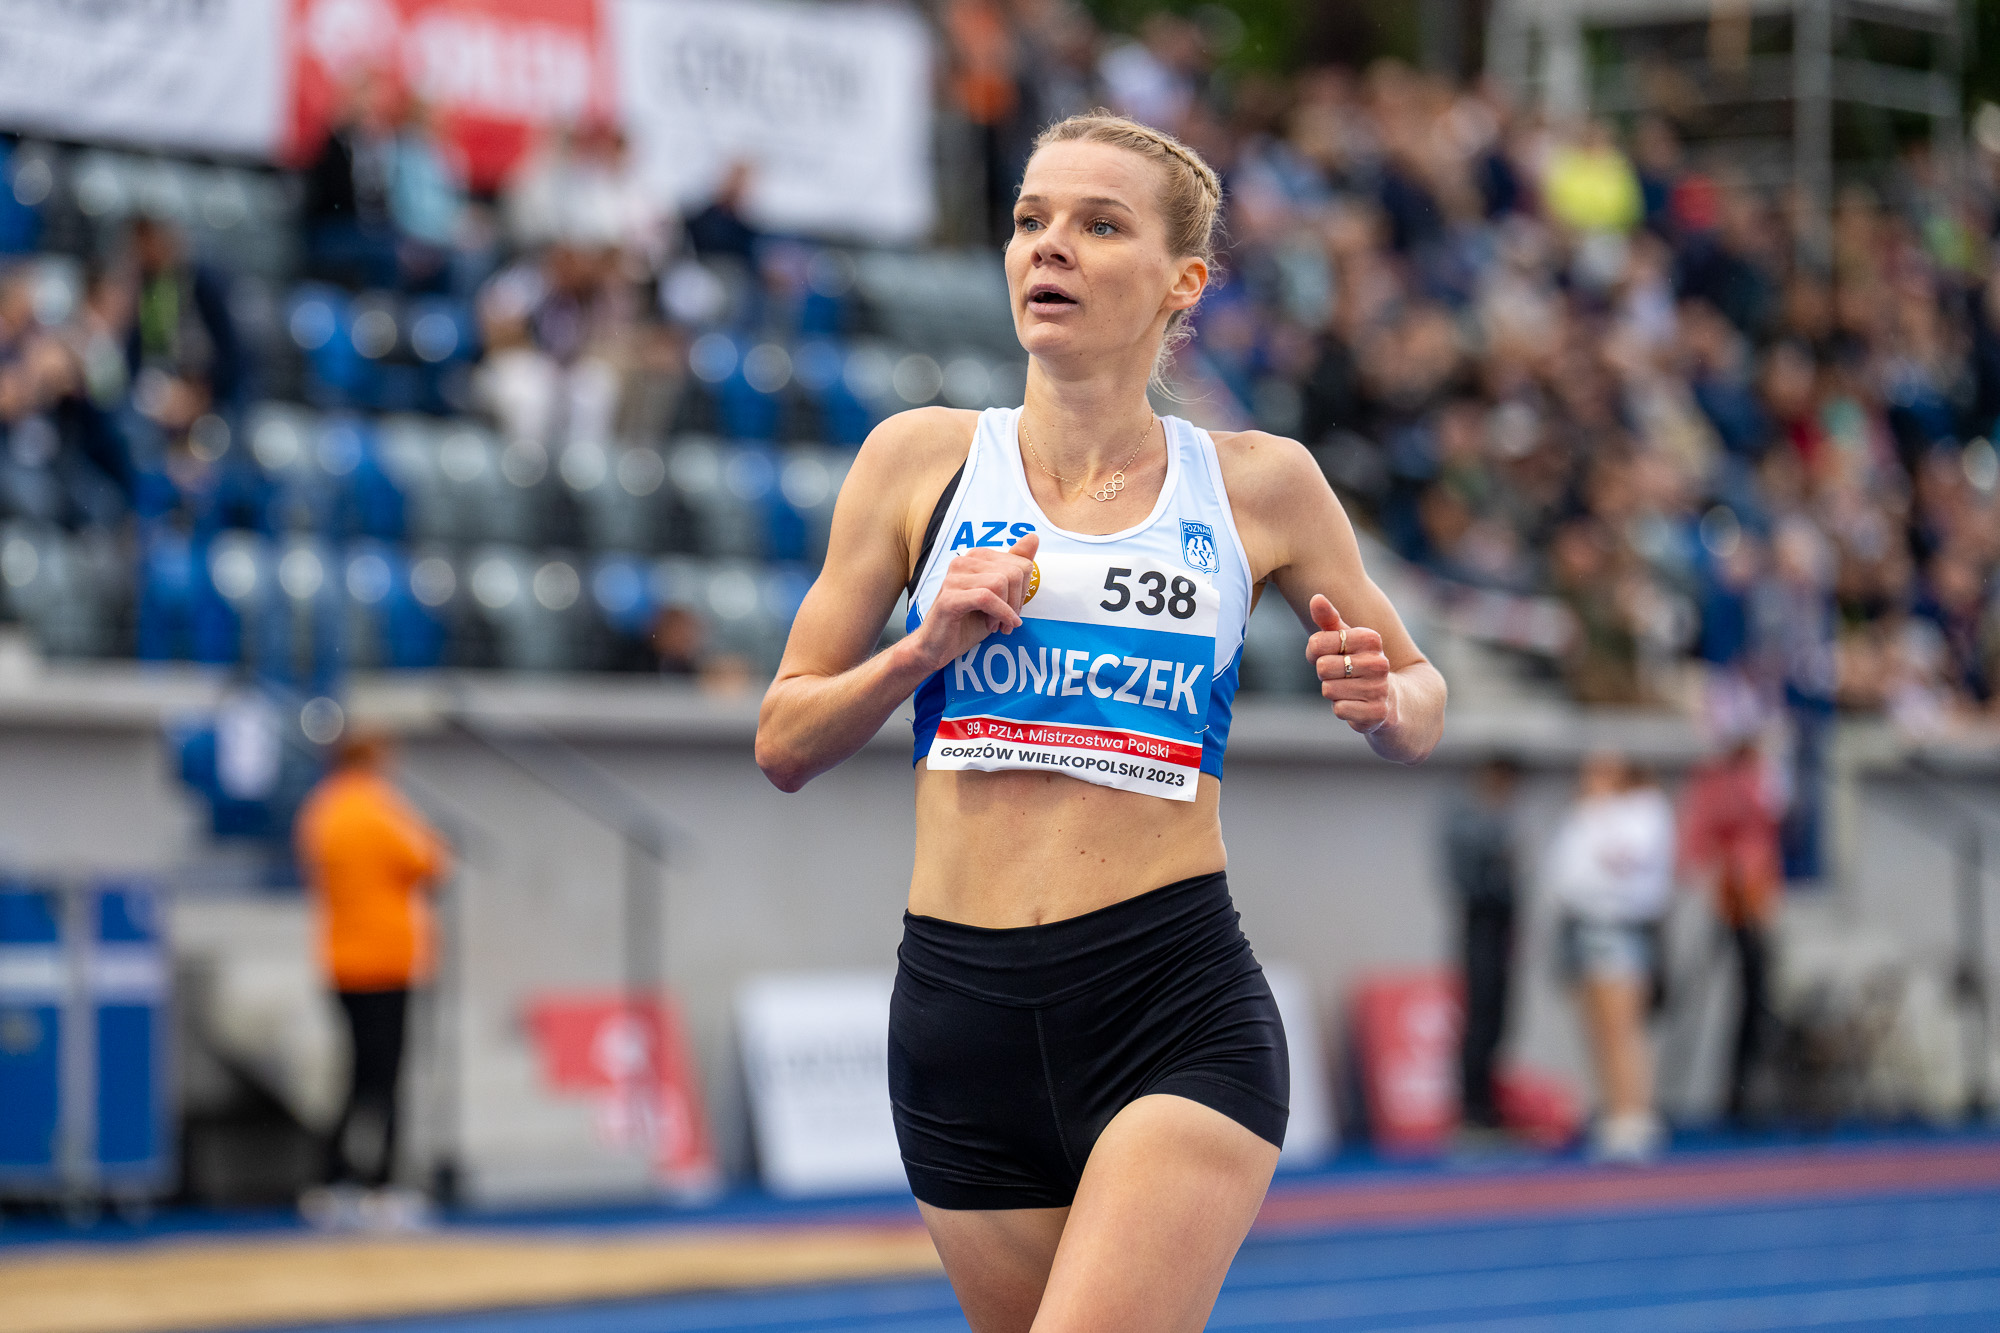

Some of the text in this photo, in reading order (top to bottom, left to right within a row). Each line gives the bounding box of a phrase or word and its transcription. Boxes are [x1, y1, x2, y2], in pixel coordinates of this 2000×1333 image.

[949, 521, 1036, 551] AZS
[1099, 566, 1197, 620] 538
[953, 642, 1205, 715] KONIECZEK
[966, 721, 1170, 759] 99. PZLA Mistrzostwa Polski
[940, 742, 1186, 788] GORZÓW WIELKOPOLSKI 2023
